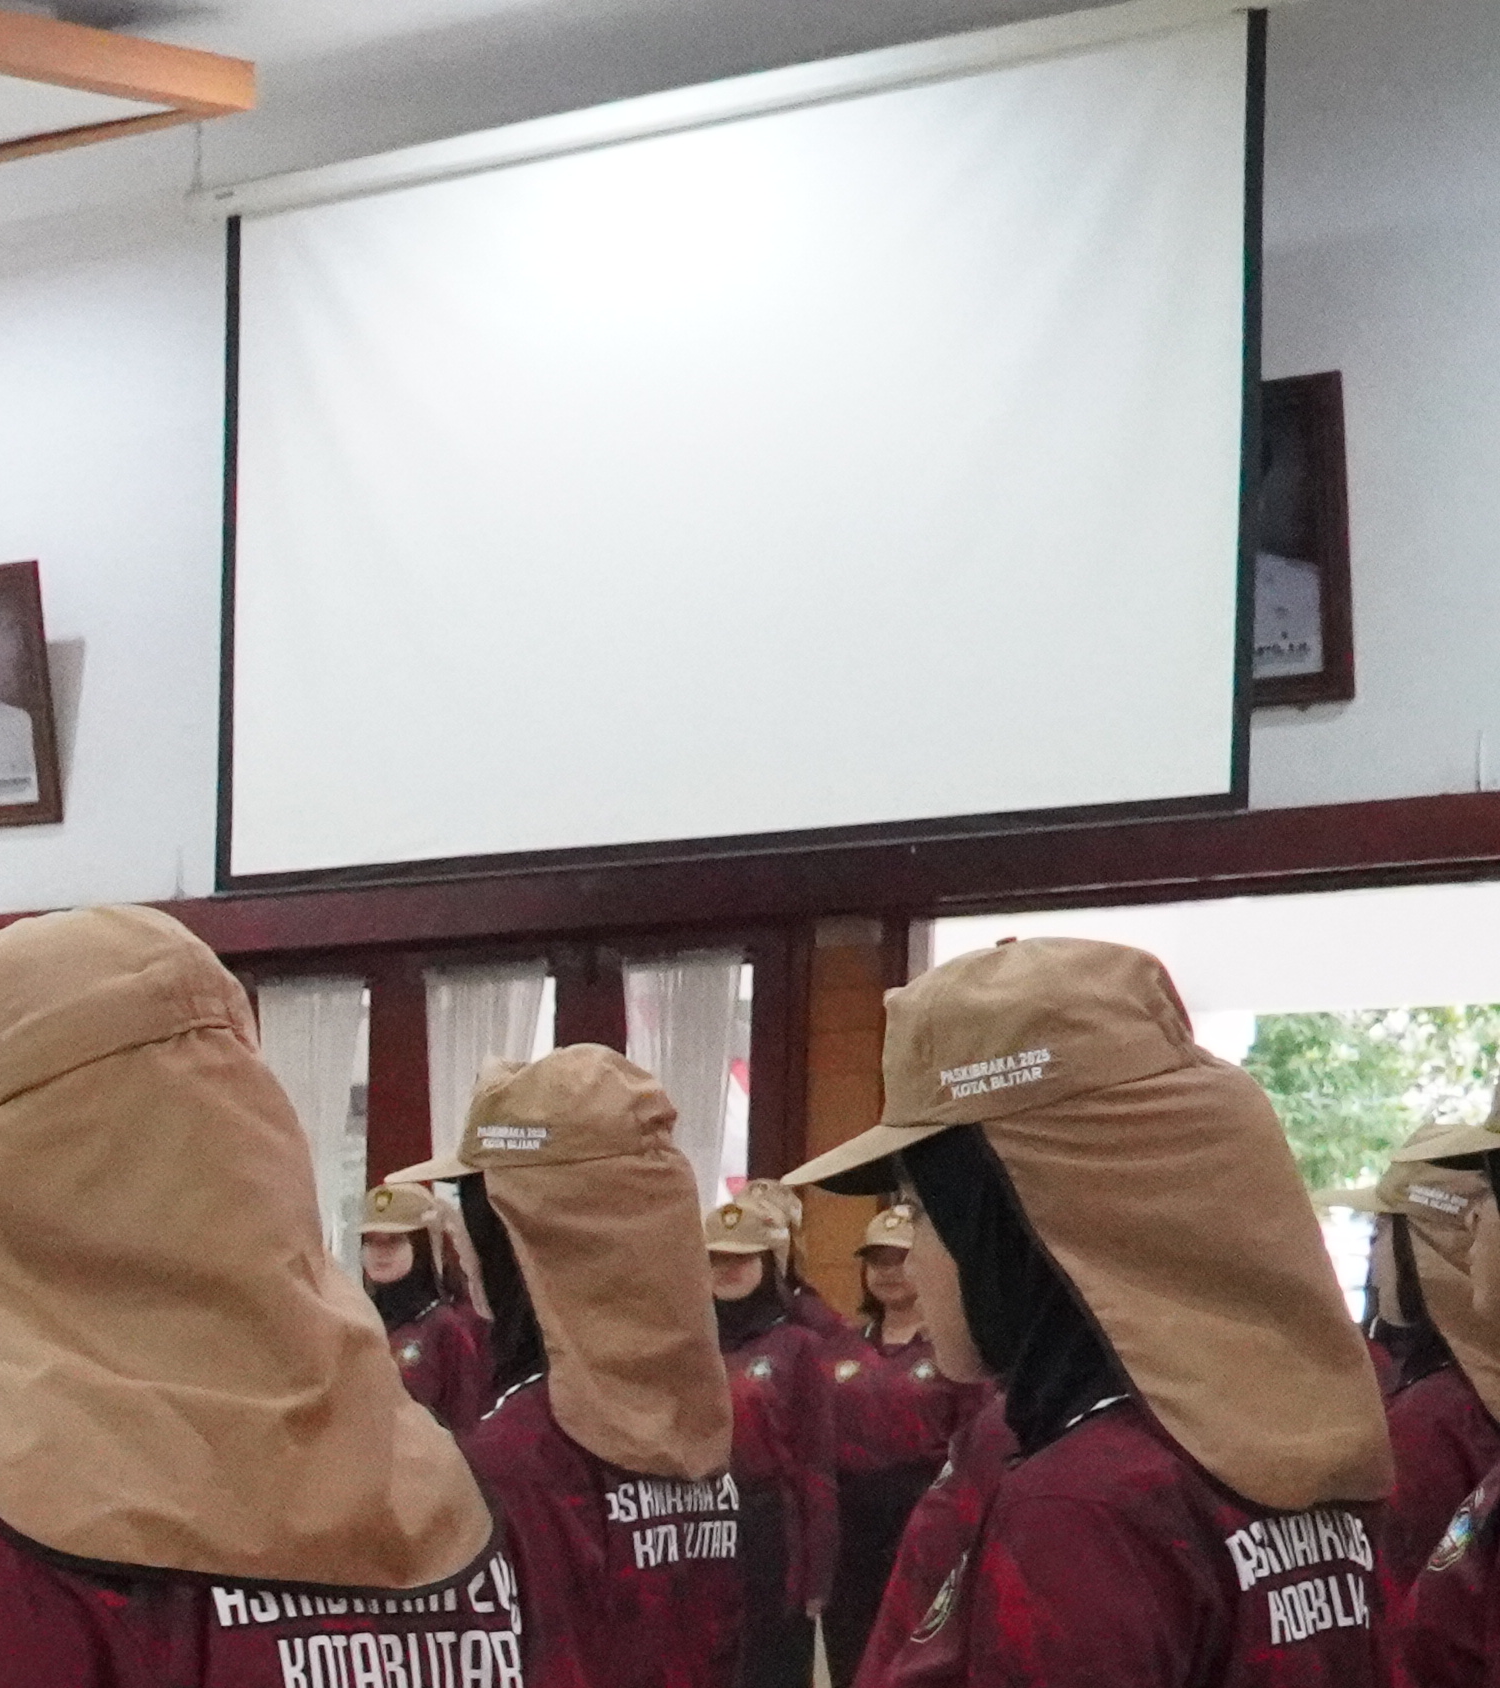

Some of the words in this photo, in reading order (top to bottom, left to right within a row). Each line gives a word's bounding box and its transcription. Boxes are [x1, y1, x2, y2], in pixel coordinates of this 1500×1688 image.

[940, 1056, 1016, 1087] PASKIBRAKA
[950, 1079, 990, 1100] KOTA
[990, 1066, 1043, 1091] BLITAR
